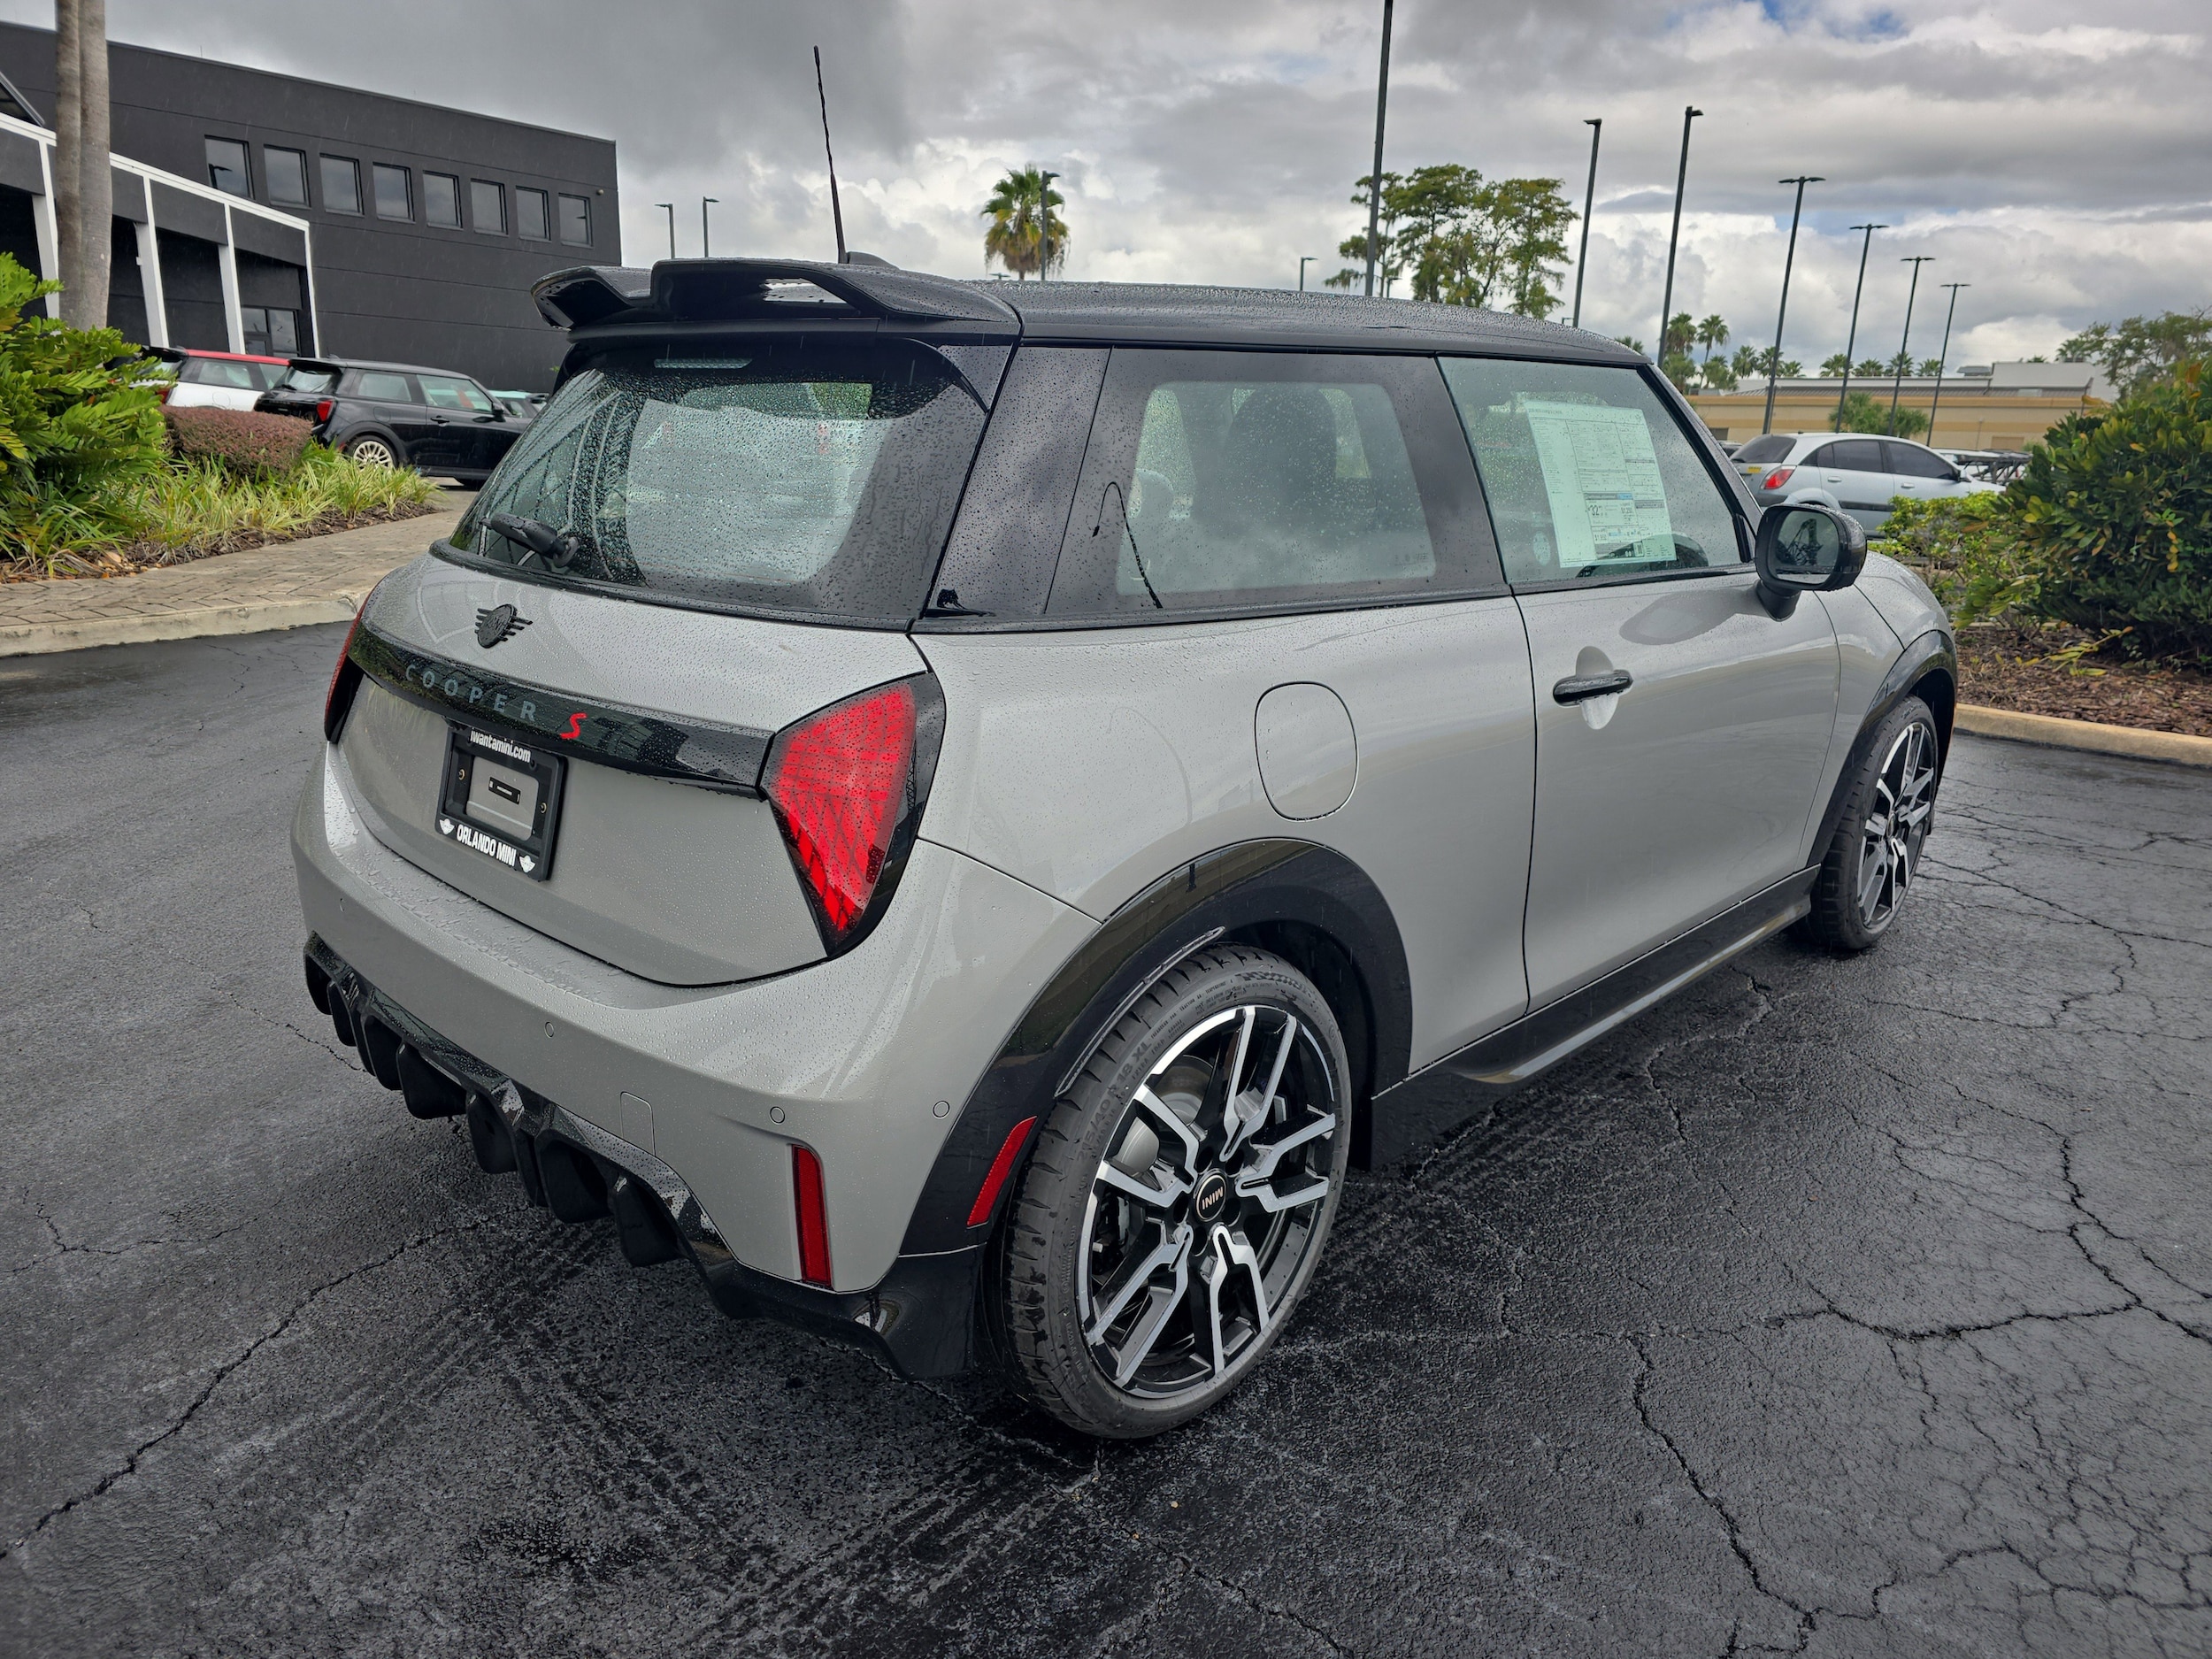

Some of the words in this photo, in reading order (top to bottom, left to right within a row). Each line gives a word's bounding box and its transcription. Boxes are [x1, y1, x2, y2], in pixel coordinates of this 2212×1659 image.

[405, 664, 537, 722] COOPER
[559, 712, 588, 740] S
[470, 727, 531, 763] iwantamini.com
[457, 824, 496, 857] ORLANDO
[495, 841, 517, 867] MINI
[1202, 1186, 1224, 1210] MINI
